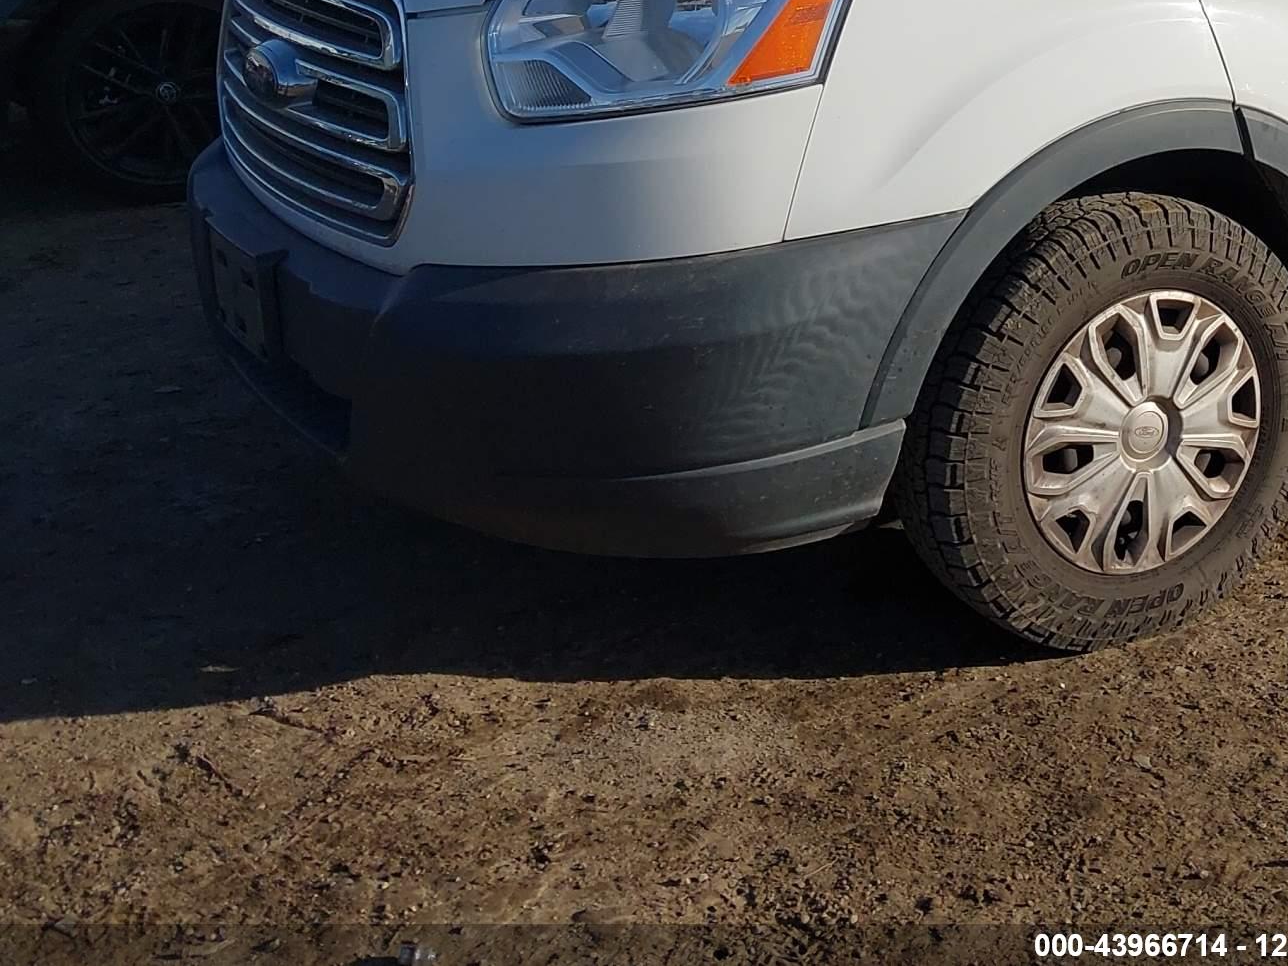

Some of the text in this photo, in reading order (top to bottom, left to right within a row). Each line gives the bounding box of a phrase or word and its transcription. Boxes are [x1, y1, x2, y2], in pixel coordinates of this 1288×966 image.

[1120, 252, 1200, 280] OPEN
[1199, 258, 1278, 319] RANGE
[1103, 583, 1185, 618] OPEN
